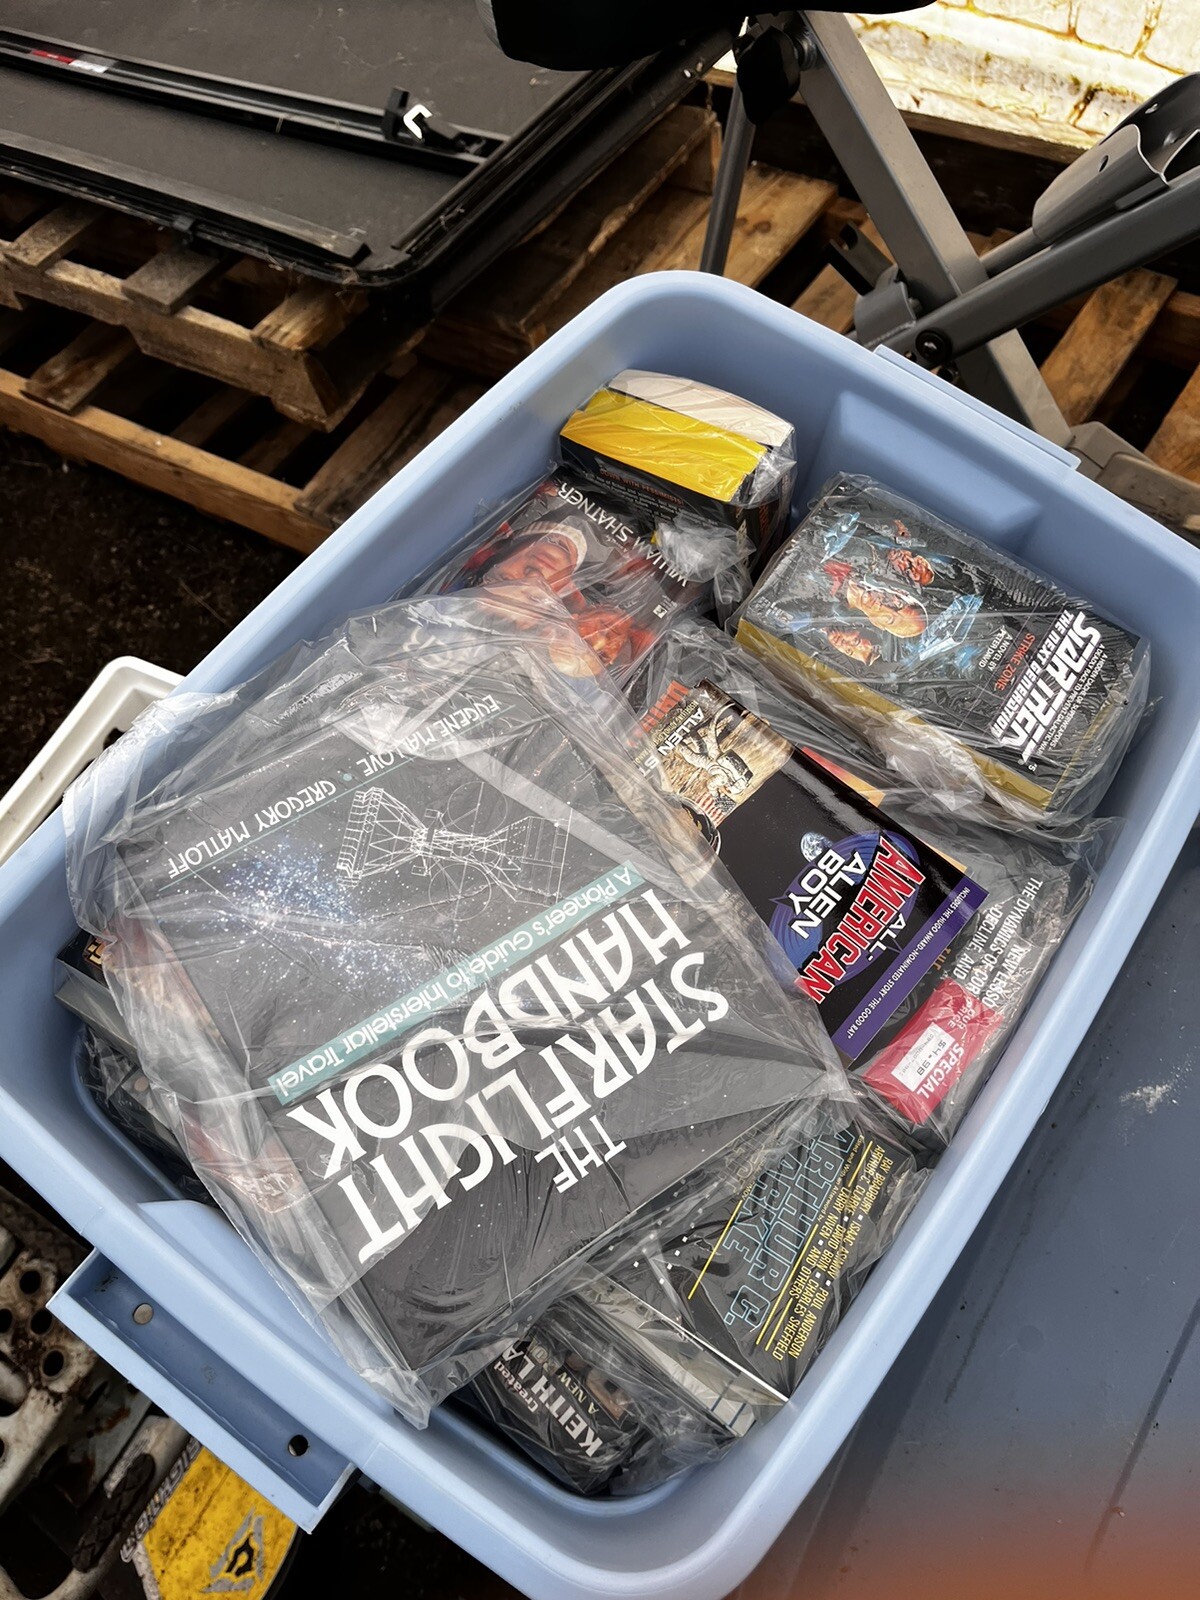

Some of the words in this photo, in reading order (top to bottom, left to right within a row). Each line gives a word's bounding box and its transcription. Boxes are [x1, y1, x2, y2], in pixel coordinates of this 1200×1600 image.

[556, 482, 634, 543] SHATNER
[1053, 610, 1074, 633] THE
[990, 628, 1006, 649] PETER
[992, 639, 1009, 662] NOVEL
[1004, 633, 1013, 642] A
[1009, 632, 1036, 666] STRIKE
[1036, 630, 1060, 664] NEXT
[1044, 610, 1103, 693] STAR
[1097, 642, 1105, 650] A
[977, 647, 994, 668] DAVID
[985, 659, 997, 672] BY
[1084, 648, 1103, 669] DEADLY
[1087, 657, 1107, 679] HIDDEN
[994, 663, 1015, 691] ZONE
[1073, 681, 1082, 691] TO
[1076, 667, 1092, 684] RACE
[1077, 677, 1095, 697] CACHE
[989, 660, 1041, 738] GENERATION
[1058, 689, 1079, 714] PREVENT
[1073, 695, 1083, 704] OF
[433, 691, 499, 739] EUGENE
[999, 677, 1066, 763] TREK
[1041, 711, 1067, 742] GALACTIC
[1048, 702, 1080, 748] SUPERWEAPONS
[657, 706, 704, 756] ALLEN
[354, 722, 436, 778] MALLOVE
[637, 753, 660, 776] ST
[249, 774, 337, 833] GREGORY
[161, 817, 250, 878] MATLOFF
[612, 866, 635, 890] A
[786, 848, 844, 913] BOY
[1020, 875, 1043, 900] THE
[530, 876, 618, 941] Pioneer's
[789, 851, 864, 939] ALIEN
[947, 886, 971, 910] INCLUDES
[793, 835, 924, 1004] AMERICAN
[929, 915, 947, 933] HUGO
[942, 907, 953, 918] THE
[989, 897, 1030, 956] DYNAMICS
[864, 912, 906, 963] ALL-
[964, 905, 1004, 956] DECLINE,
[466, 926, 537, 979] Guide
[890, 930, 934, 981] AWARD-NOMINATED
[950, 952, 976, 980] AND
[978, 951, 998, 971] OF
[1000, 943, 1026, 972] NEW
[442, 965, 471, 993] to
[876, 978, 895, 997] STORY
[964, 968, 988, 997] COR
[980, 970, 1009, 1008] LESSO
[339, 980, 447, 1056] Interstellar
[853, 1006, 872, 1026] GOOD
[955, 1007, 976, 1030] OUR
[284, 887, 692, 1179] HANDBOOK
[274, 1042, 344, 1097] Travel
[915, 1042, 964, 1100] SPECIAL
[333, 945, 731, 1263] STARFLIGHT
[533, 1114, 626, 1193] THE
[845, 1151, 855, 1163] and
[862, 1144, 886, 1175] ARTHUR
[878, 1156, 893, 1173] RAY
[722, 1100, 827, 1263] CLARKE
[857, 1172, 886, 1215] BRADBURY
[858, 1174, 870, 1185] C.
[747, 1114, 856, 1291] ARTHUR
[818, 1185, 839, 1218] Afterword
[831, 1186, 852, 1213] LARRY
[842, 1184, 866, 1216] CLARKE
[815, 1215, 823, 1223] by
[818, 1211, 839, 1239] NIVEN
[841, 1219, 862, 1246] ISAAC
[826, 1223, 847, 1250] DAVID
[804, 1245, 822, 1266] AND
[815, 1248, 835, 1272] BRIN
[825, 1245, 850, 1280] ASIMOV
[787, 1265, 812, 1299] OTHERS
[792, 1278, 818, 1315] CHARLES
[722, 1283, 770, 1328] C.
[809, 1286, 828, 1312] POUL
[771, 1314, 799, 1360] SHEFFIELD
[786, 1311, 817, 1359] ANDERSON
[500, 1341, 537, 1380] LA
[492, 1359, 540, 1412] Created
[557, 1369, 588, 1403] NEW
[528, 1374, 603, 1457] KEITH
[584, 1401, 599, 1416] A
